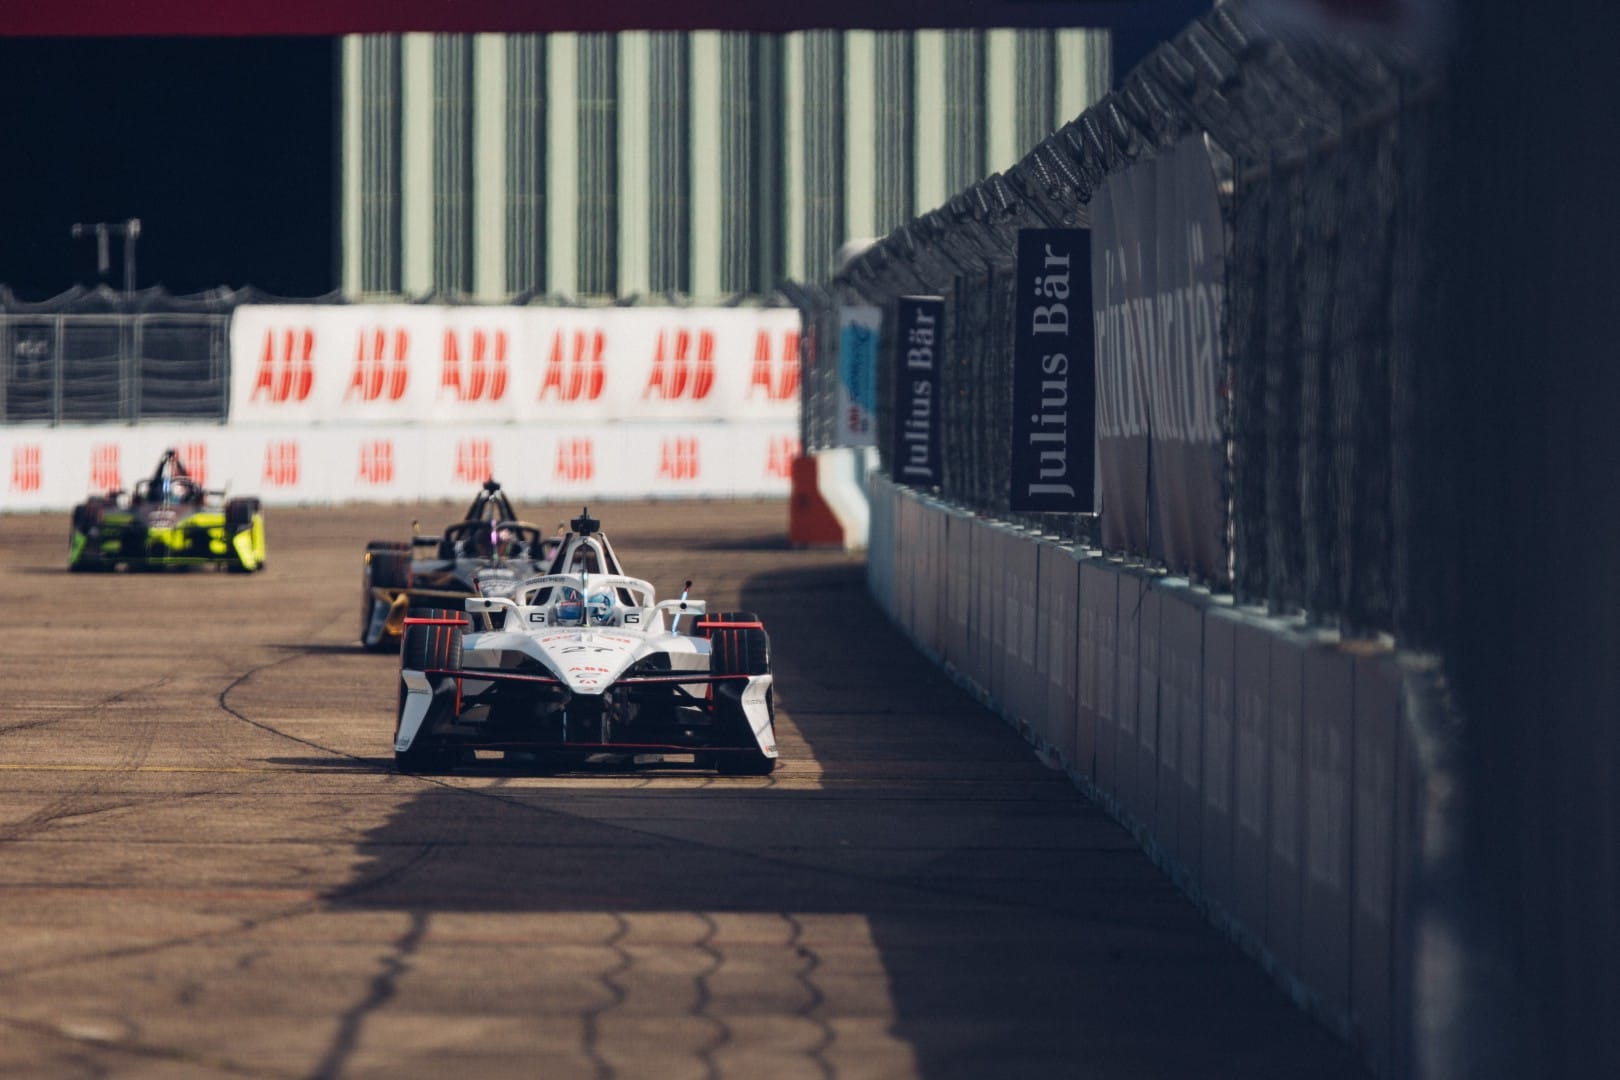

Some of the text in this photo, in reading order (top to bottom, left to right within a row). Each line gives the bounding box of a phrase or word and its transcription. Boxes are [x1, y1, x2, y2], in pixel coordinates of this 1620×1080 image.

[249, 327, 317, 405] ABB
[345, 327, 411, 404] ABB
[438, 328, 510, 404] ABB
[537, 328, 608, 403] ABB
[642, 328, 718, 402] ABB
[749, 328, 803, 402] AB
[903, 309, 936, 477] Julius Bär
[1029, 243, 1075, 497] Julius Bär
[263, 441, 300, 487] ABB
[359, 441, 396, 484] ABB
[455, 440, 493, 484] ABB
[555, 439, 596, 482] ABB
[658, 438, 701, 480] ABB
[529, 612, 545, 623] G
[624, 613, 640, 624] G
